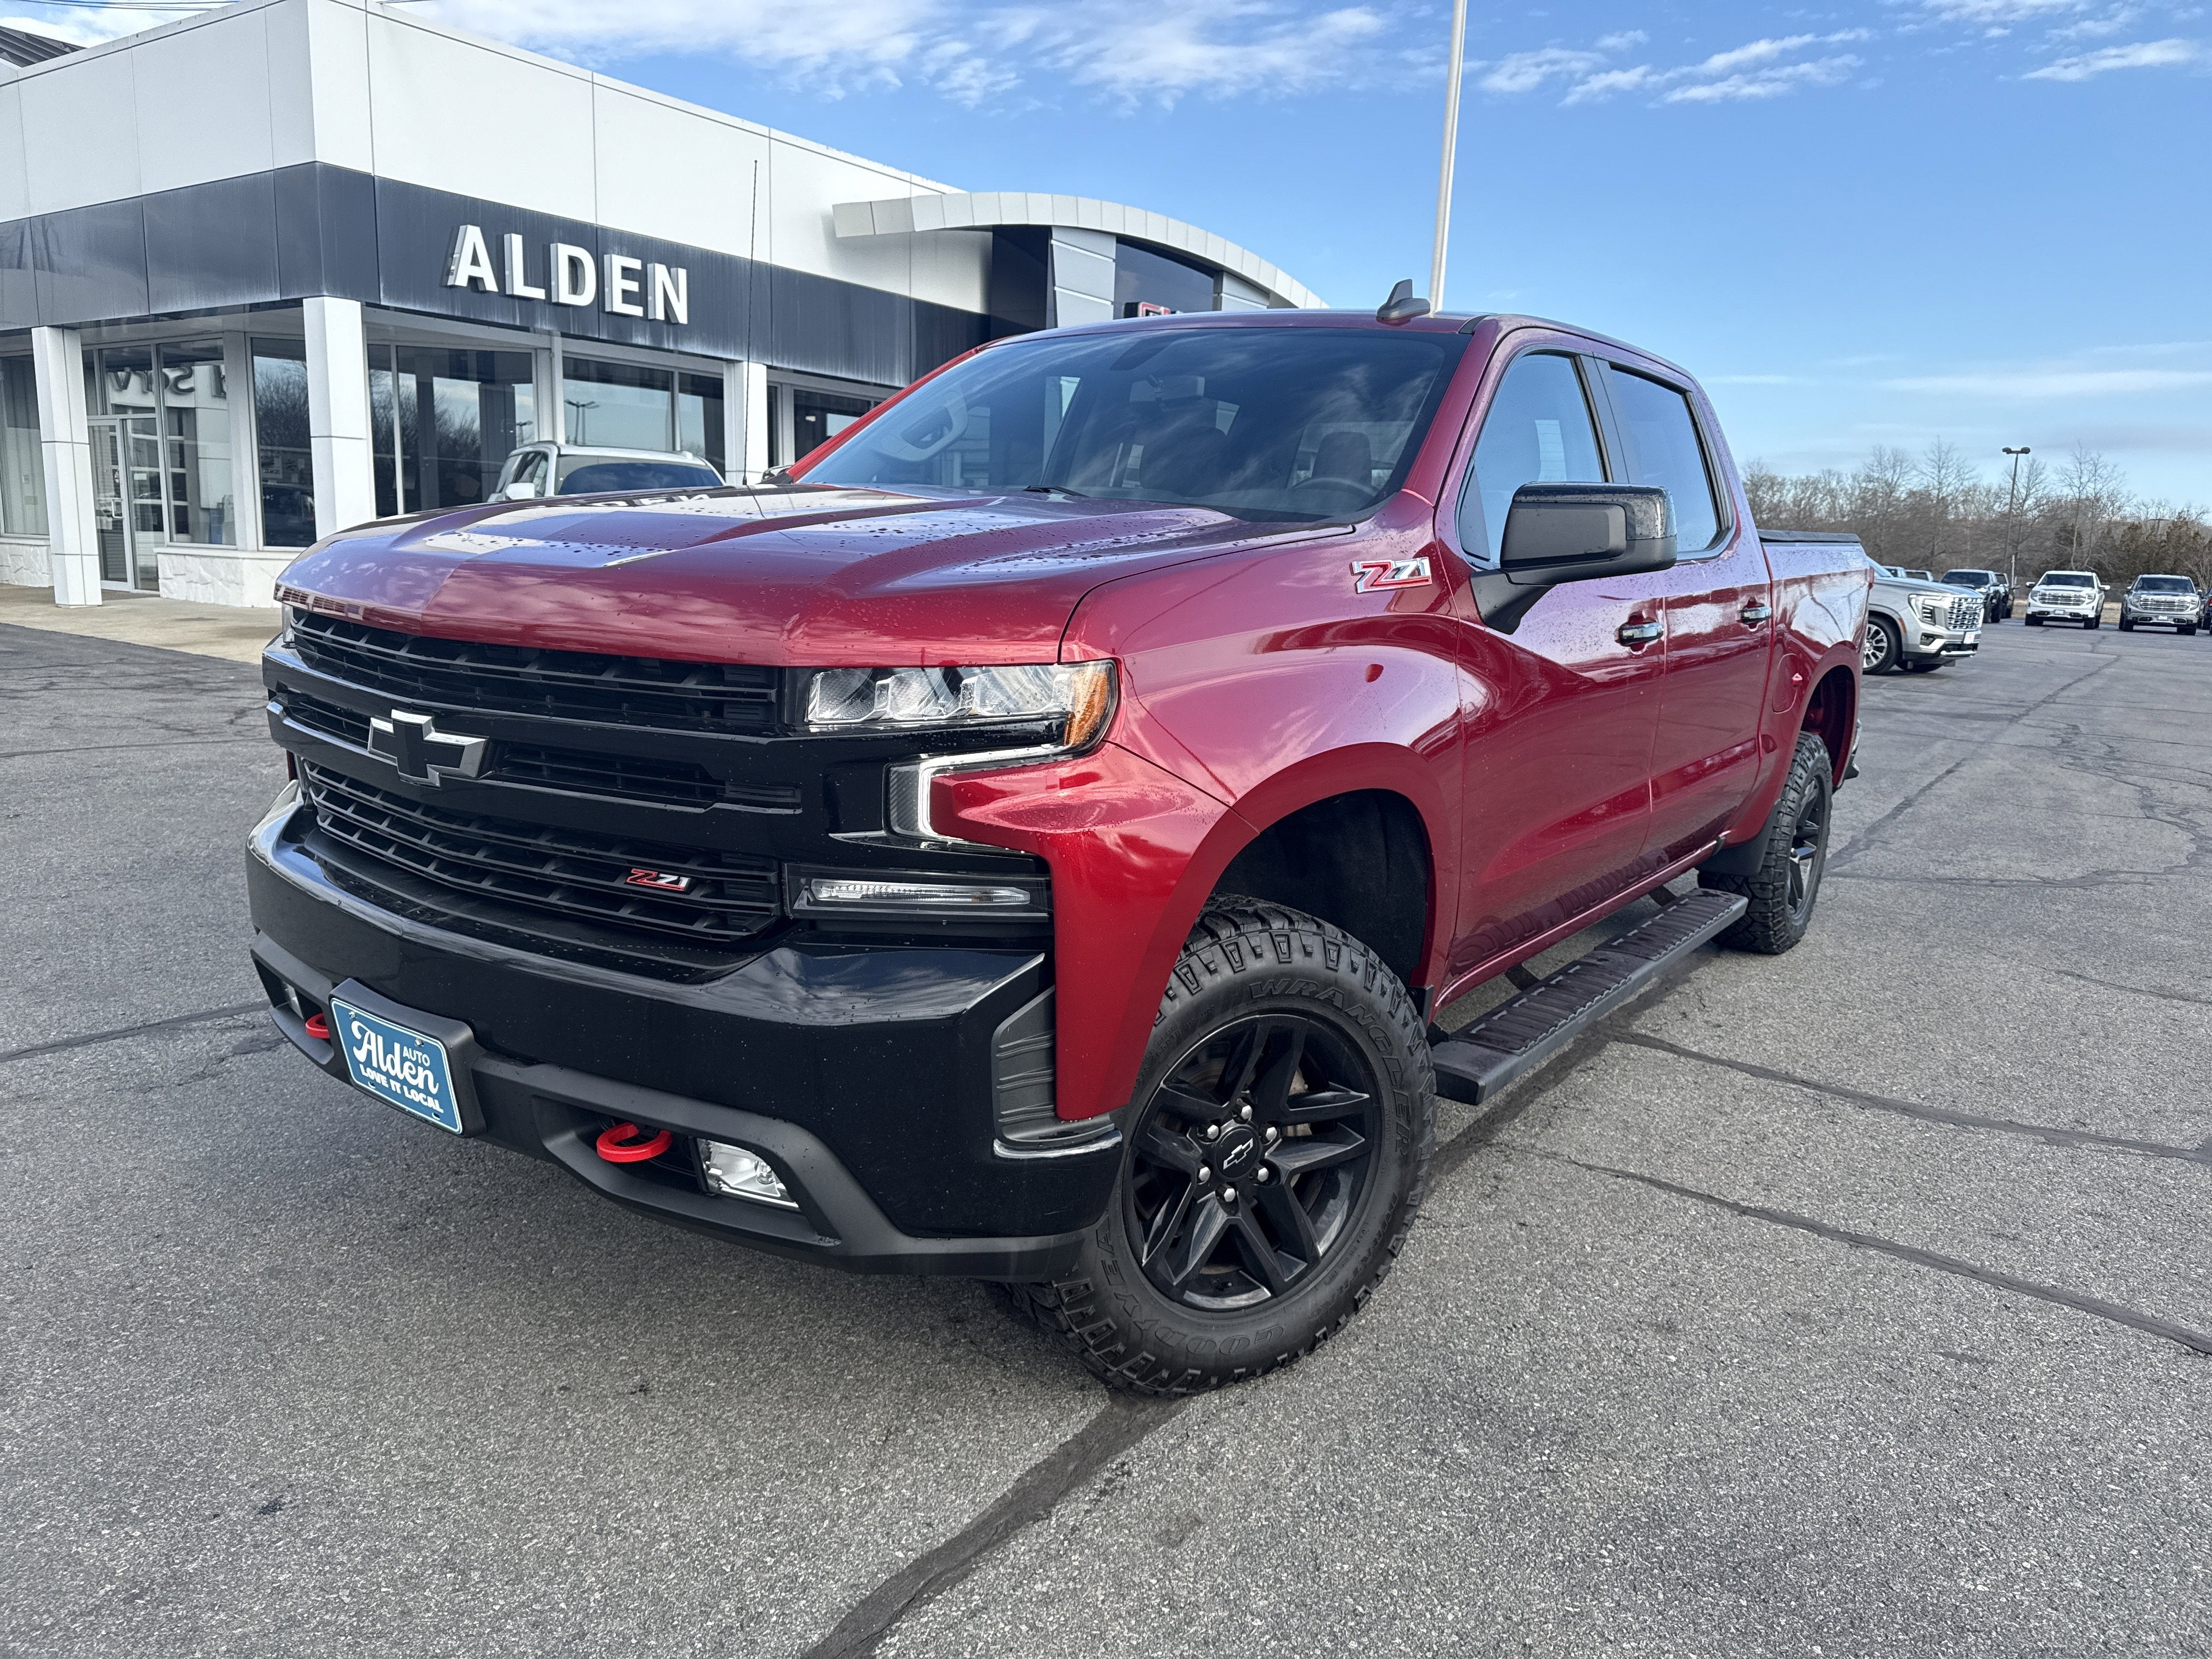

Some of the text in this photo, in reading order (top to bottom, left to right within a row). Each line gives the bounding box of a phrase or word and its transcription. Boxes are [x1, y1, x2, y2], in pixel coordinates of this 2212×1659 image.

[447, 224, 687, 324] ALDEN
[1351, 556, 1432, 594] Z71
[627, 868, 691, 891] Z71
[351, 1020, 439, 1094] Alden
[403, 1046, 430, 1066] AUTO
[1249, 978, 1410, 1156] WRANGLER
[359, 1064, 444, 1113] LOVE IT LOCAL
[1096, 1210, 1284, 1355] GOODYEA
